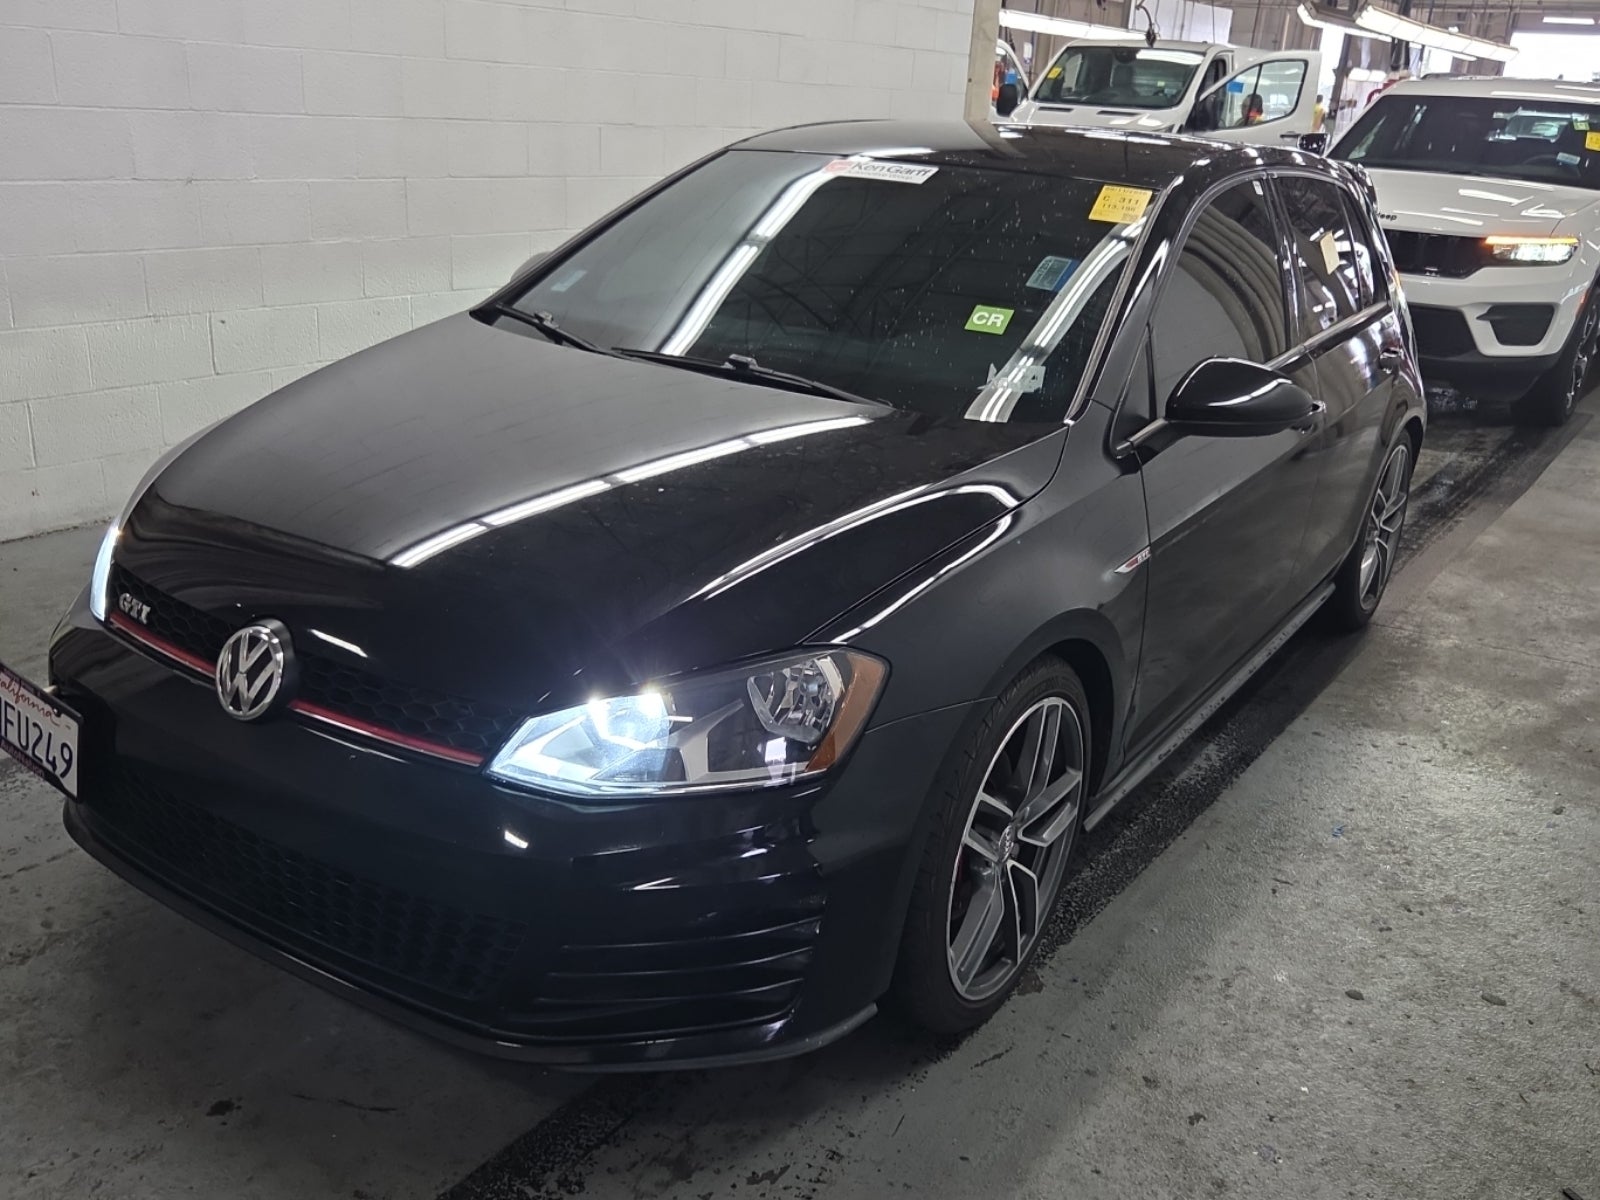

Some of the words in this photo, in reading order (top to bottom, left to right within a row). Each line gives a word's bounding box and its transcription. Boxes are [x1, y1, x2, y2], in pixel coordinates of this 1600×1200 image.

[851, 162, 885, 172] Ken
[887, 165, 934, 177] Garff
[973, 311, 1004, 327] CR
[119, 592, 151, 624] GTI
[0, 678, 60, 727] alifornia
